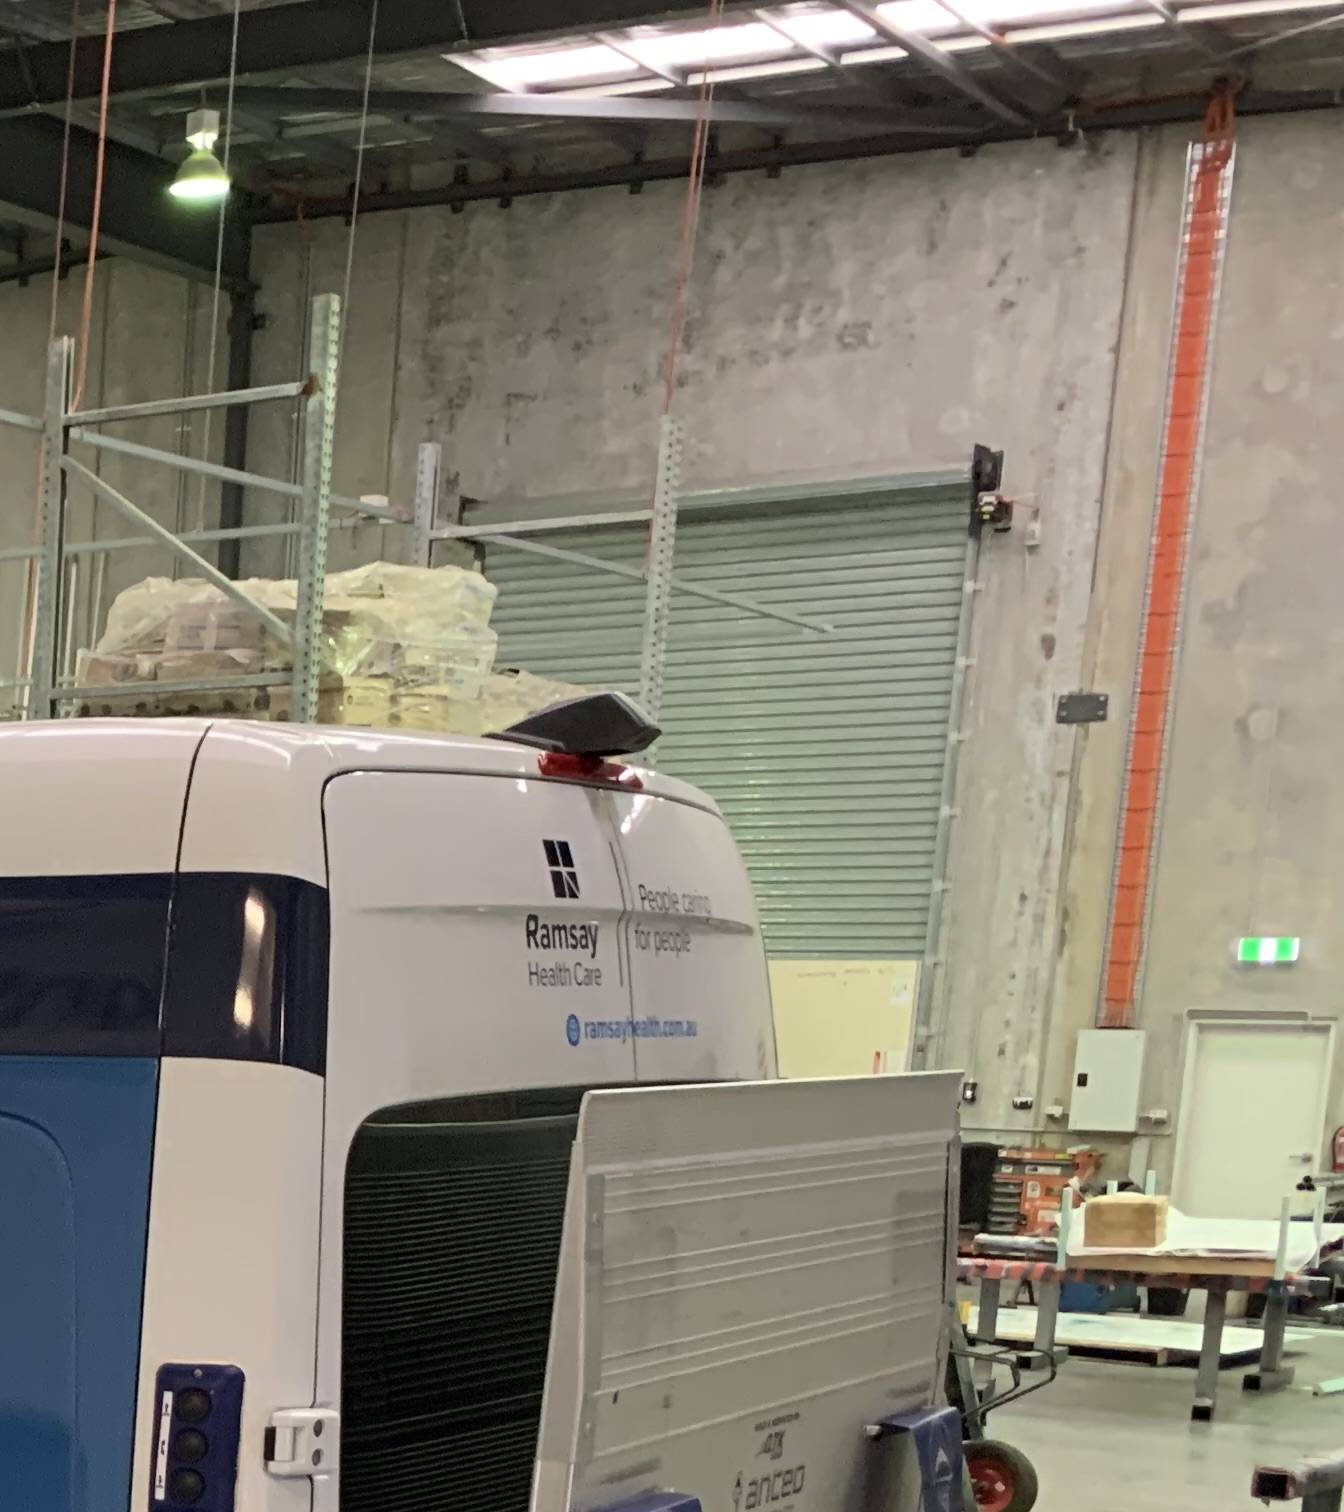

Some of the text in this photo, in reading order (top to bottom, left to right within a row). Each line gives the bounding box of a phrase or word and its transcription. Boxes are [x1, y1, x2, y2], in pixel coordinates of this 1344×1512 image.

[637, 884, 679, 913] People
[525, 914, 599, 958] Ramsay
[634, 922, 691, 959] for people
[528, 961, 603, 987] Health Care
